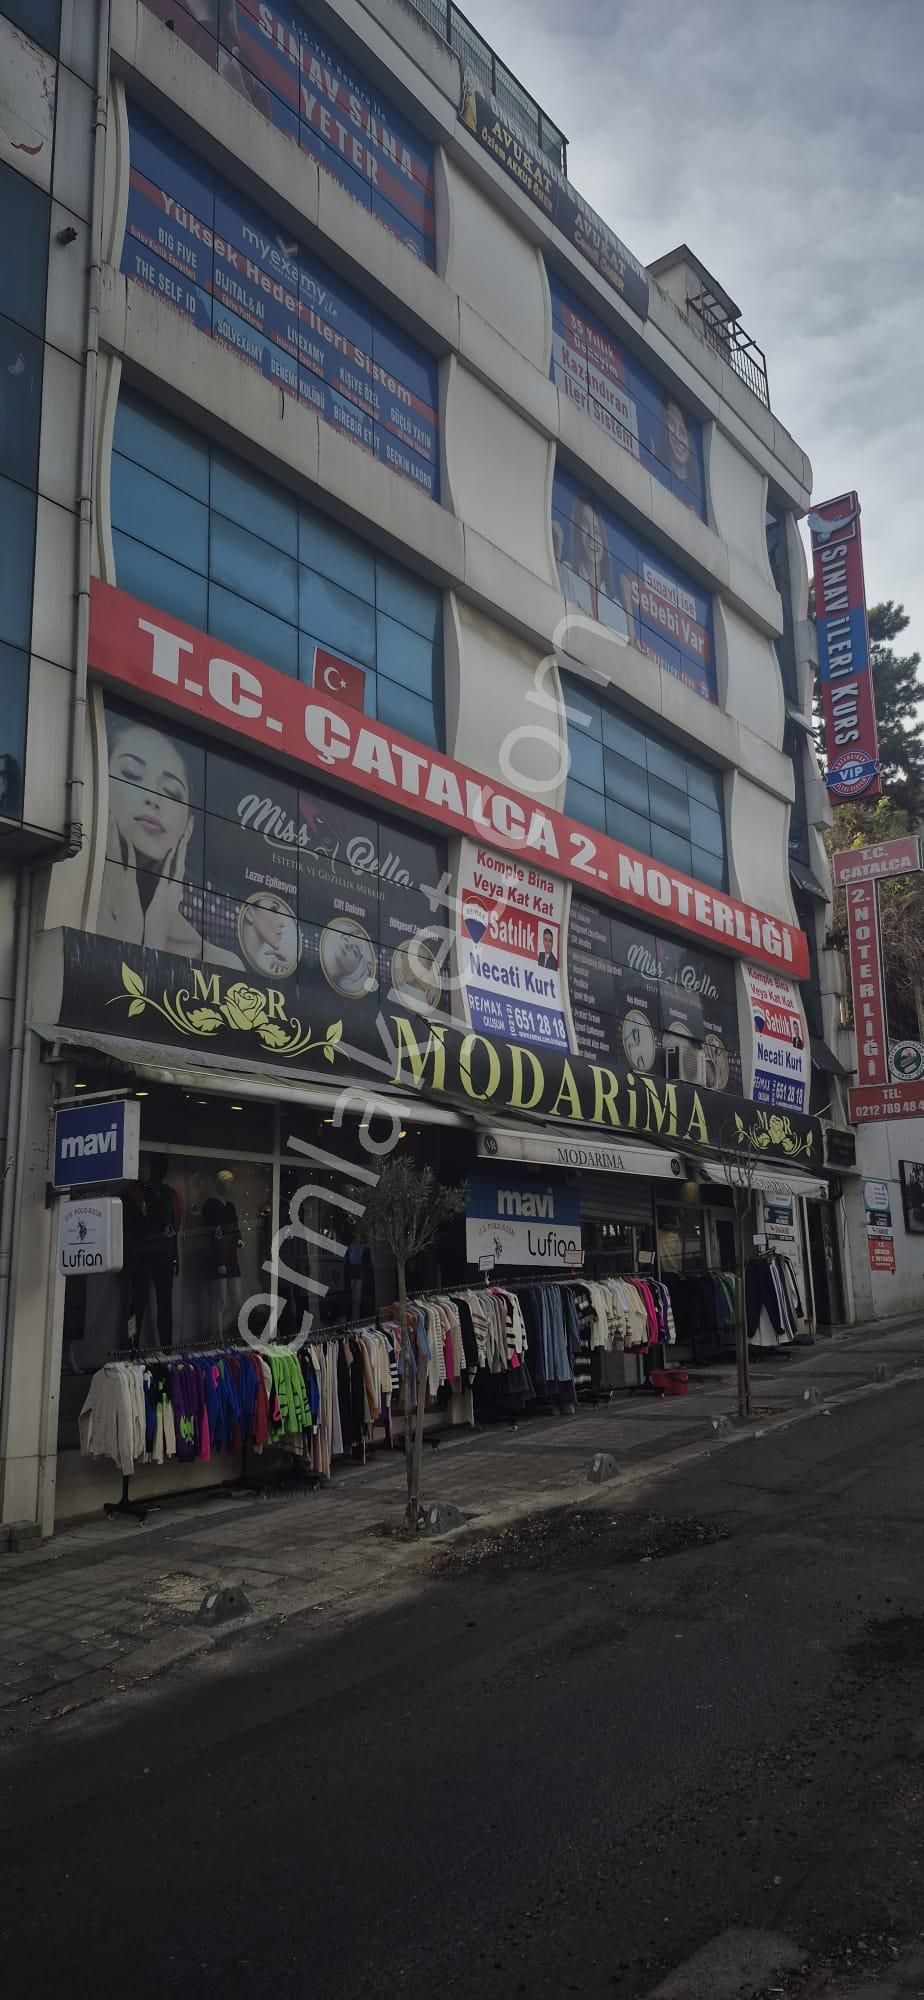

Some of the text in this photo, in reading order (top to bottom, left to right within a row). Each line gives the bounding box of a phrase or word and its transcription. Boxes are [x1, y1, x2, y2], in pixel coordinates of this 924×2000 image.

[257, 3, 340, 103] SINAV
[349, 95, 415, 180] SANA
[300, 84, 378, 184] YETER
[492, 121, 552, 193] AVUKAT
[158, 226, 197, 269] BIG FIVE
[574, 213, 626, 276] AVUKAT
[135, 255, 155, 285] THE
[158, 272, 183, 303] SELF
[186, 293, 196, 314] ID
[160, 189, 239, 269] Yüksek
[246, 258, 303, 318] Hedef
[354, 348, 412, 408] Sistem
[569, 313, 584, 334] 35
[561, 343, 629, 419] Kazandıran
[592, 398, 633, 449] Sistem
[410, 462, 432, 489] KADRO
[820, 544, 850, 612] SINAV
[631, 580, 705, 654] Sebebi Var
[831, 682, 860, 746] KURS
[138, 618, 283, 733] T.C.
[304, 704, 560, 860] ÇATALCA
[569, 831, 608, 881] 2.
[617, 851, 794, 963] NOTERLİĞİ
[839, 765, 863, 782] VIP
[237, 794, 415, 891] Miss Bella
[859, 847, 889, 861] T.C.
[245, 867, 297, 895] Lazer Epilasyon
[476, 849, 554, 894] Komple Bina
[839, 857, 912, 881] ÇATALCA
[473, 872, 554, 917] Veya Kat Kat
[489, 911, 536, 953] Satılık
[469, 951, 521, 989] Necati
[524, 970, 556, 999] Kurt
[627, 944, 664, 978] Miss
[681, 965, 719, 1000] Bella
[851, 888, 879, 1077] 2. NOTERLİĞİ
[191, 968, 288, 1020] M R
[468, 993, 503, 1017] RE/MAX
[750, 983, 794, 1009] Veya Kat Kat
[514, 1007, 535, 1032] 651
[536, 1012, 551, 1036] 28
[552, 1016, 566, 1040] 18
[765, 1009, 791, 1037] Satılık
[757, 1042, 802, 1072] Necati Kurt
[775, 1082, 787, 1100] 651
[855, 1104, 880, 1117] 0212
[881, 1102, 901, 1115] 789
[902, 1100, 916, 1113] 48
[882, 1088, 902, 1100] TEL:
[61, 1123, 117, 1159] mavi
[757, 1110, 792, 1134] M R
[556, 1146, 625, 1170] MODARİMA
[497, 1187, 555, 1219] mavi
[62, 1249, 103, 1268] Lufian
